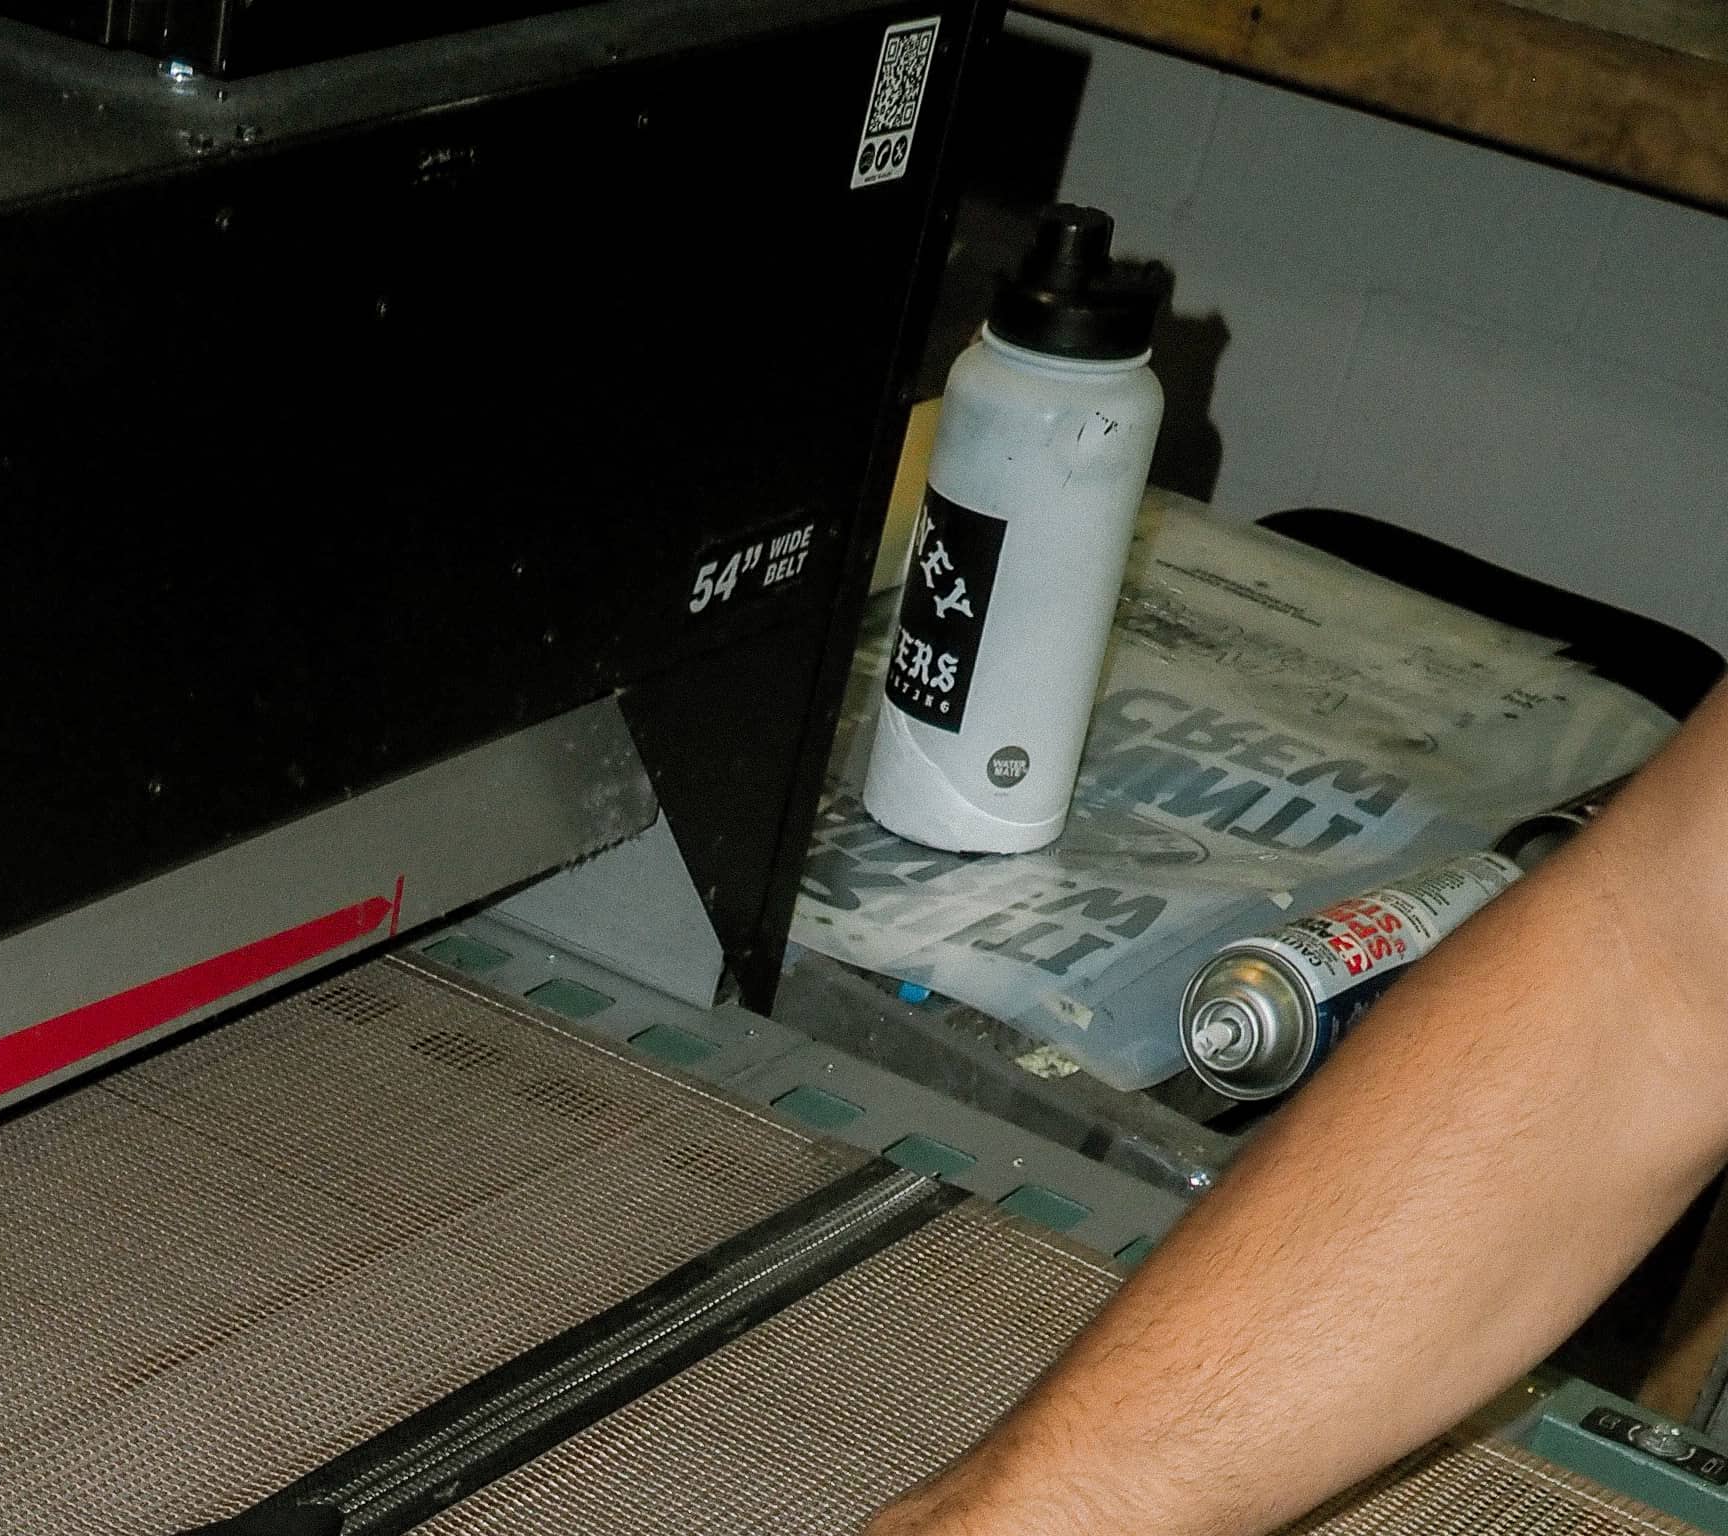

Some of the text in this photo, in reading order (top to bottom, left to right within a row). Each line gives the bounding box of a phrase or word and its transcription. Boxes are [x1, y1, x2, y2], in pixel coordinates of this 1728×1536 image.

[769, 523, 815, 560] WIDE
[762, 549, 809, 587] BELT
[992, 759, 1028, 769] WATER
[993, 766, 1024, 777] MATE
